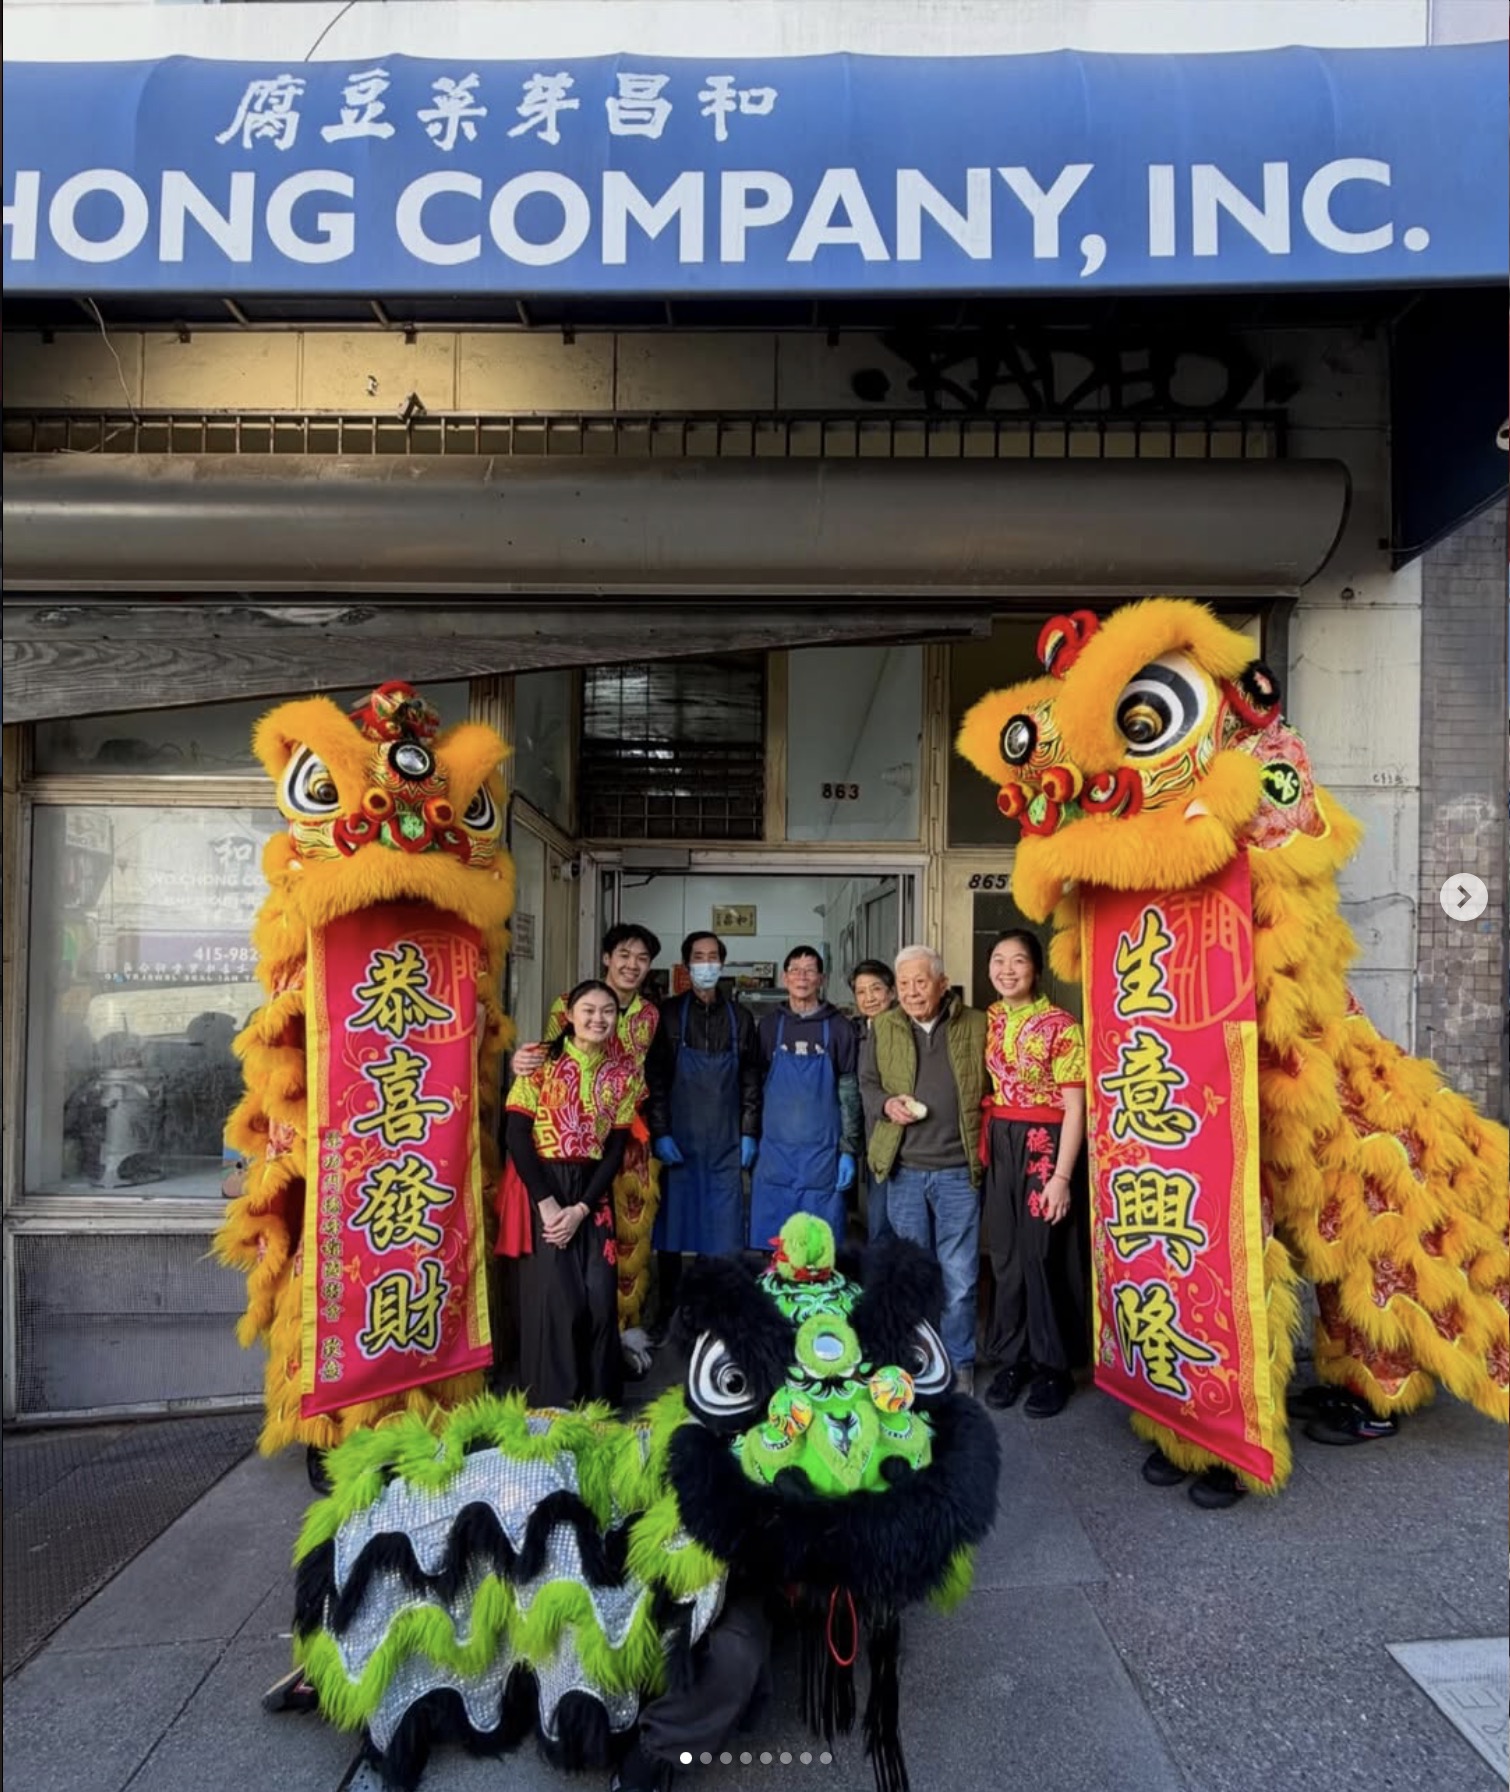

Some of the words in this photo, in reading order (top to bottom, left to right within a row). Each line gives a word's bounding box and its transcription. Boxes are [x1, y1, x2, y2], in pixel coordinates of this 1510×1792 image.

[396, 164, 1107, 277] COMPANY,
[1148, 158, 1431, 257] INC.
[822, 782, 860, 799] 863
[349, 942, 457, 1360] 恭喜發財
[1097, 906, 1222, 1399] 生意興隆
